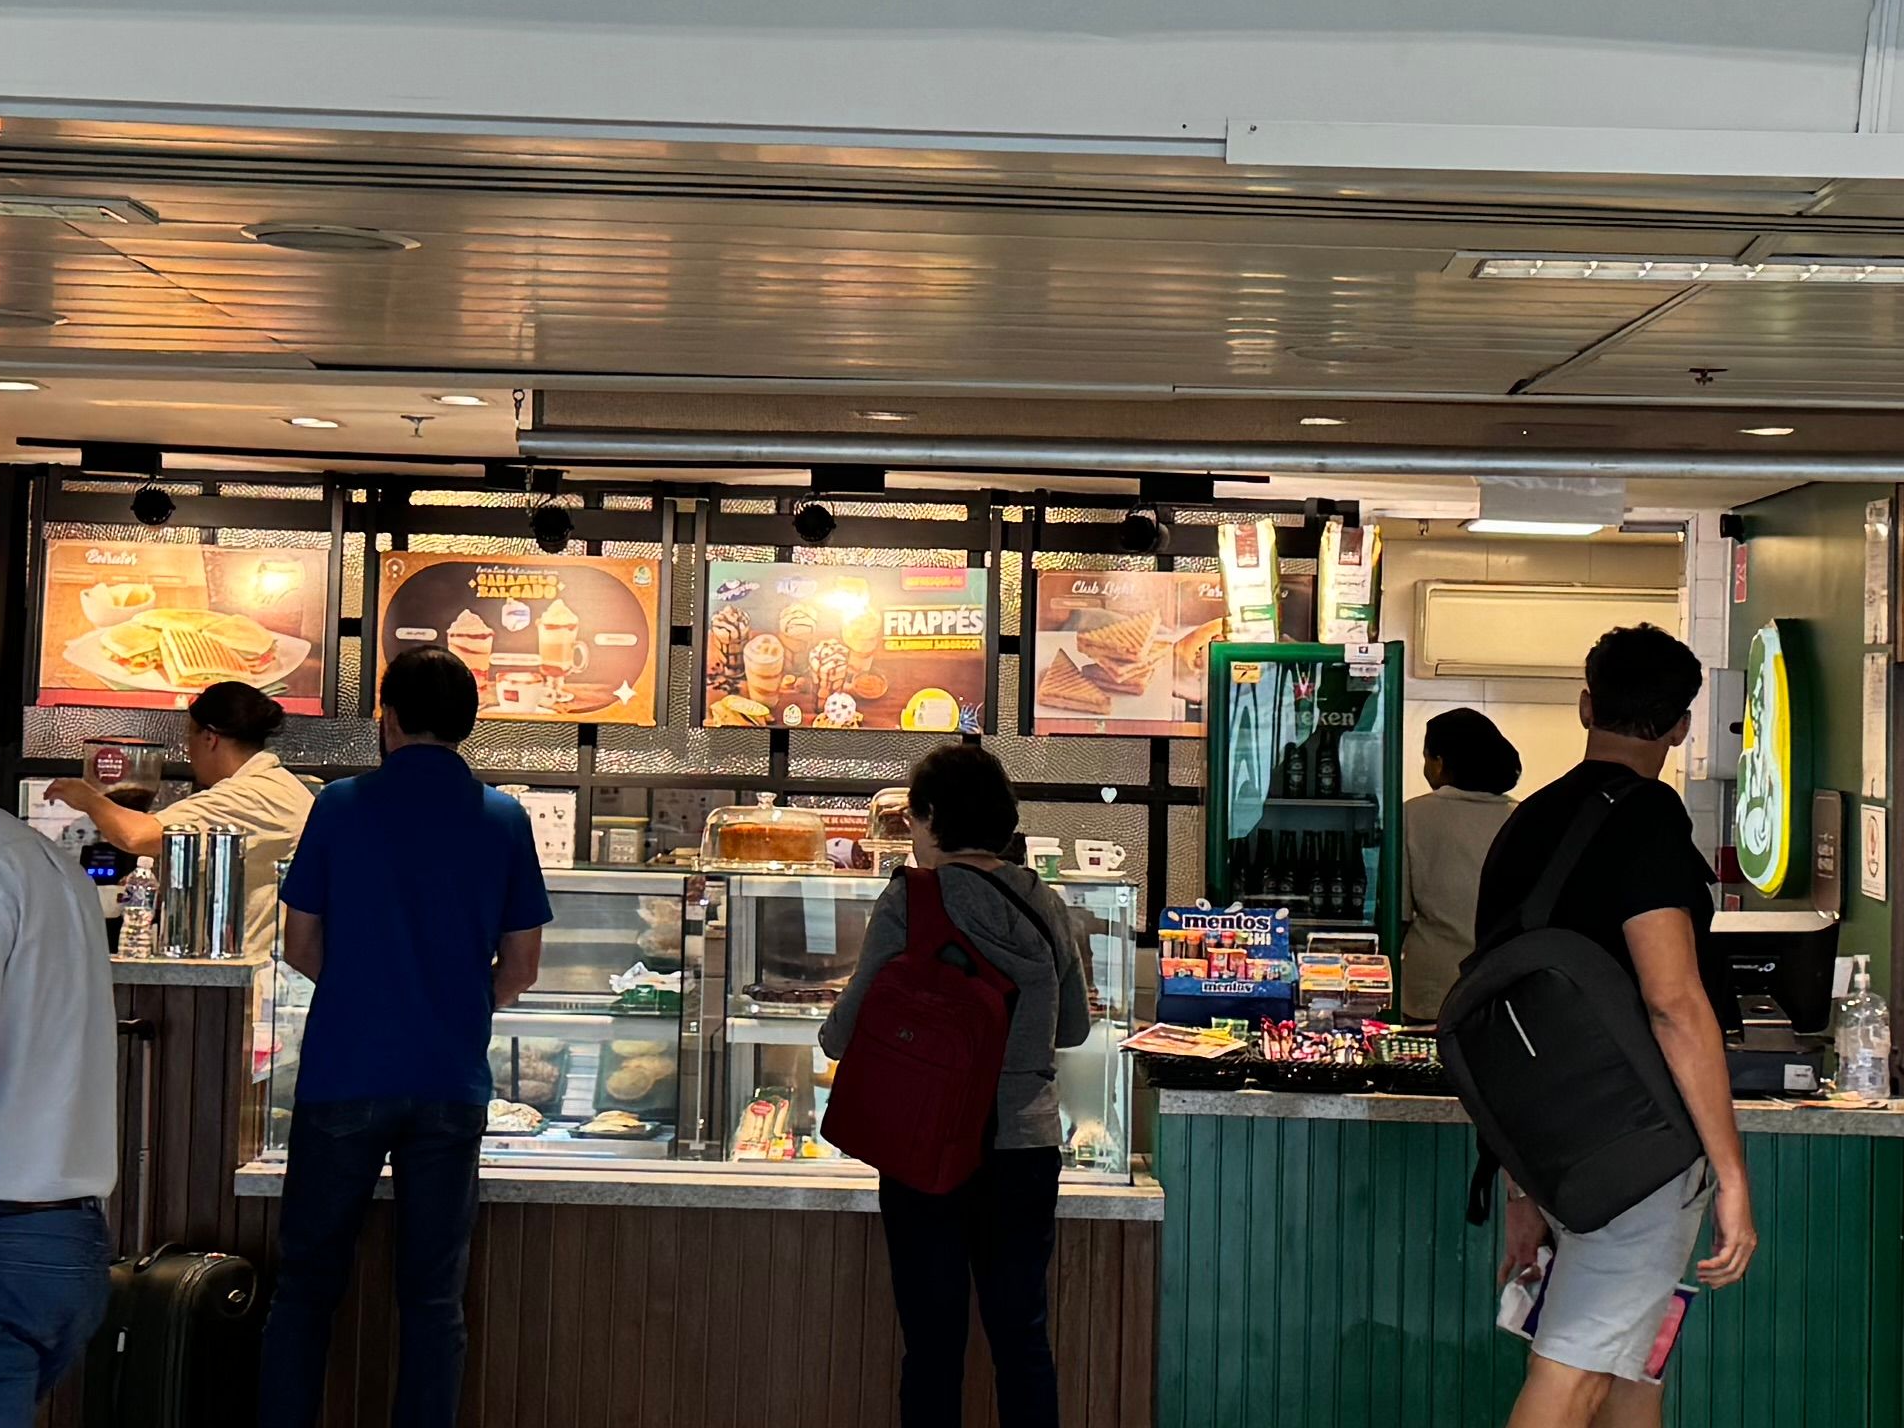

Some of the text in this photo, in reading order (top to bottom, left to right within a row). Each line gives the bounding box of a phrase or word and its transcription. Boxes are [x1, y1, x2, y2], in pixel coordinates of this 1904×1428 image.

[1071, 580, 1137, 600] Club Light
[883, 604, 984, 636] FRAPPÉS
[1182, 913, 1271, 932] mentos
[1201, 981, 1255, 993] mentos
